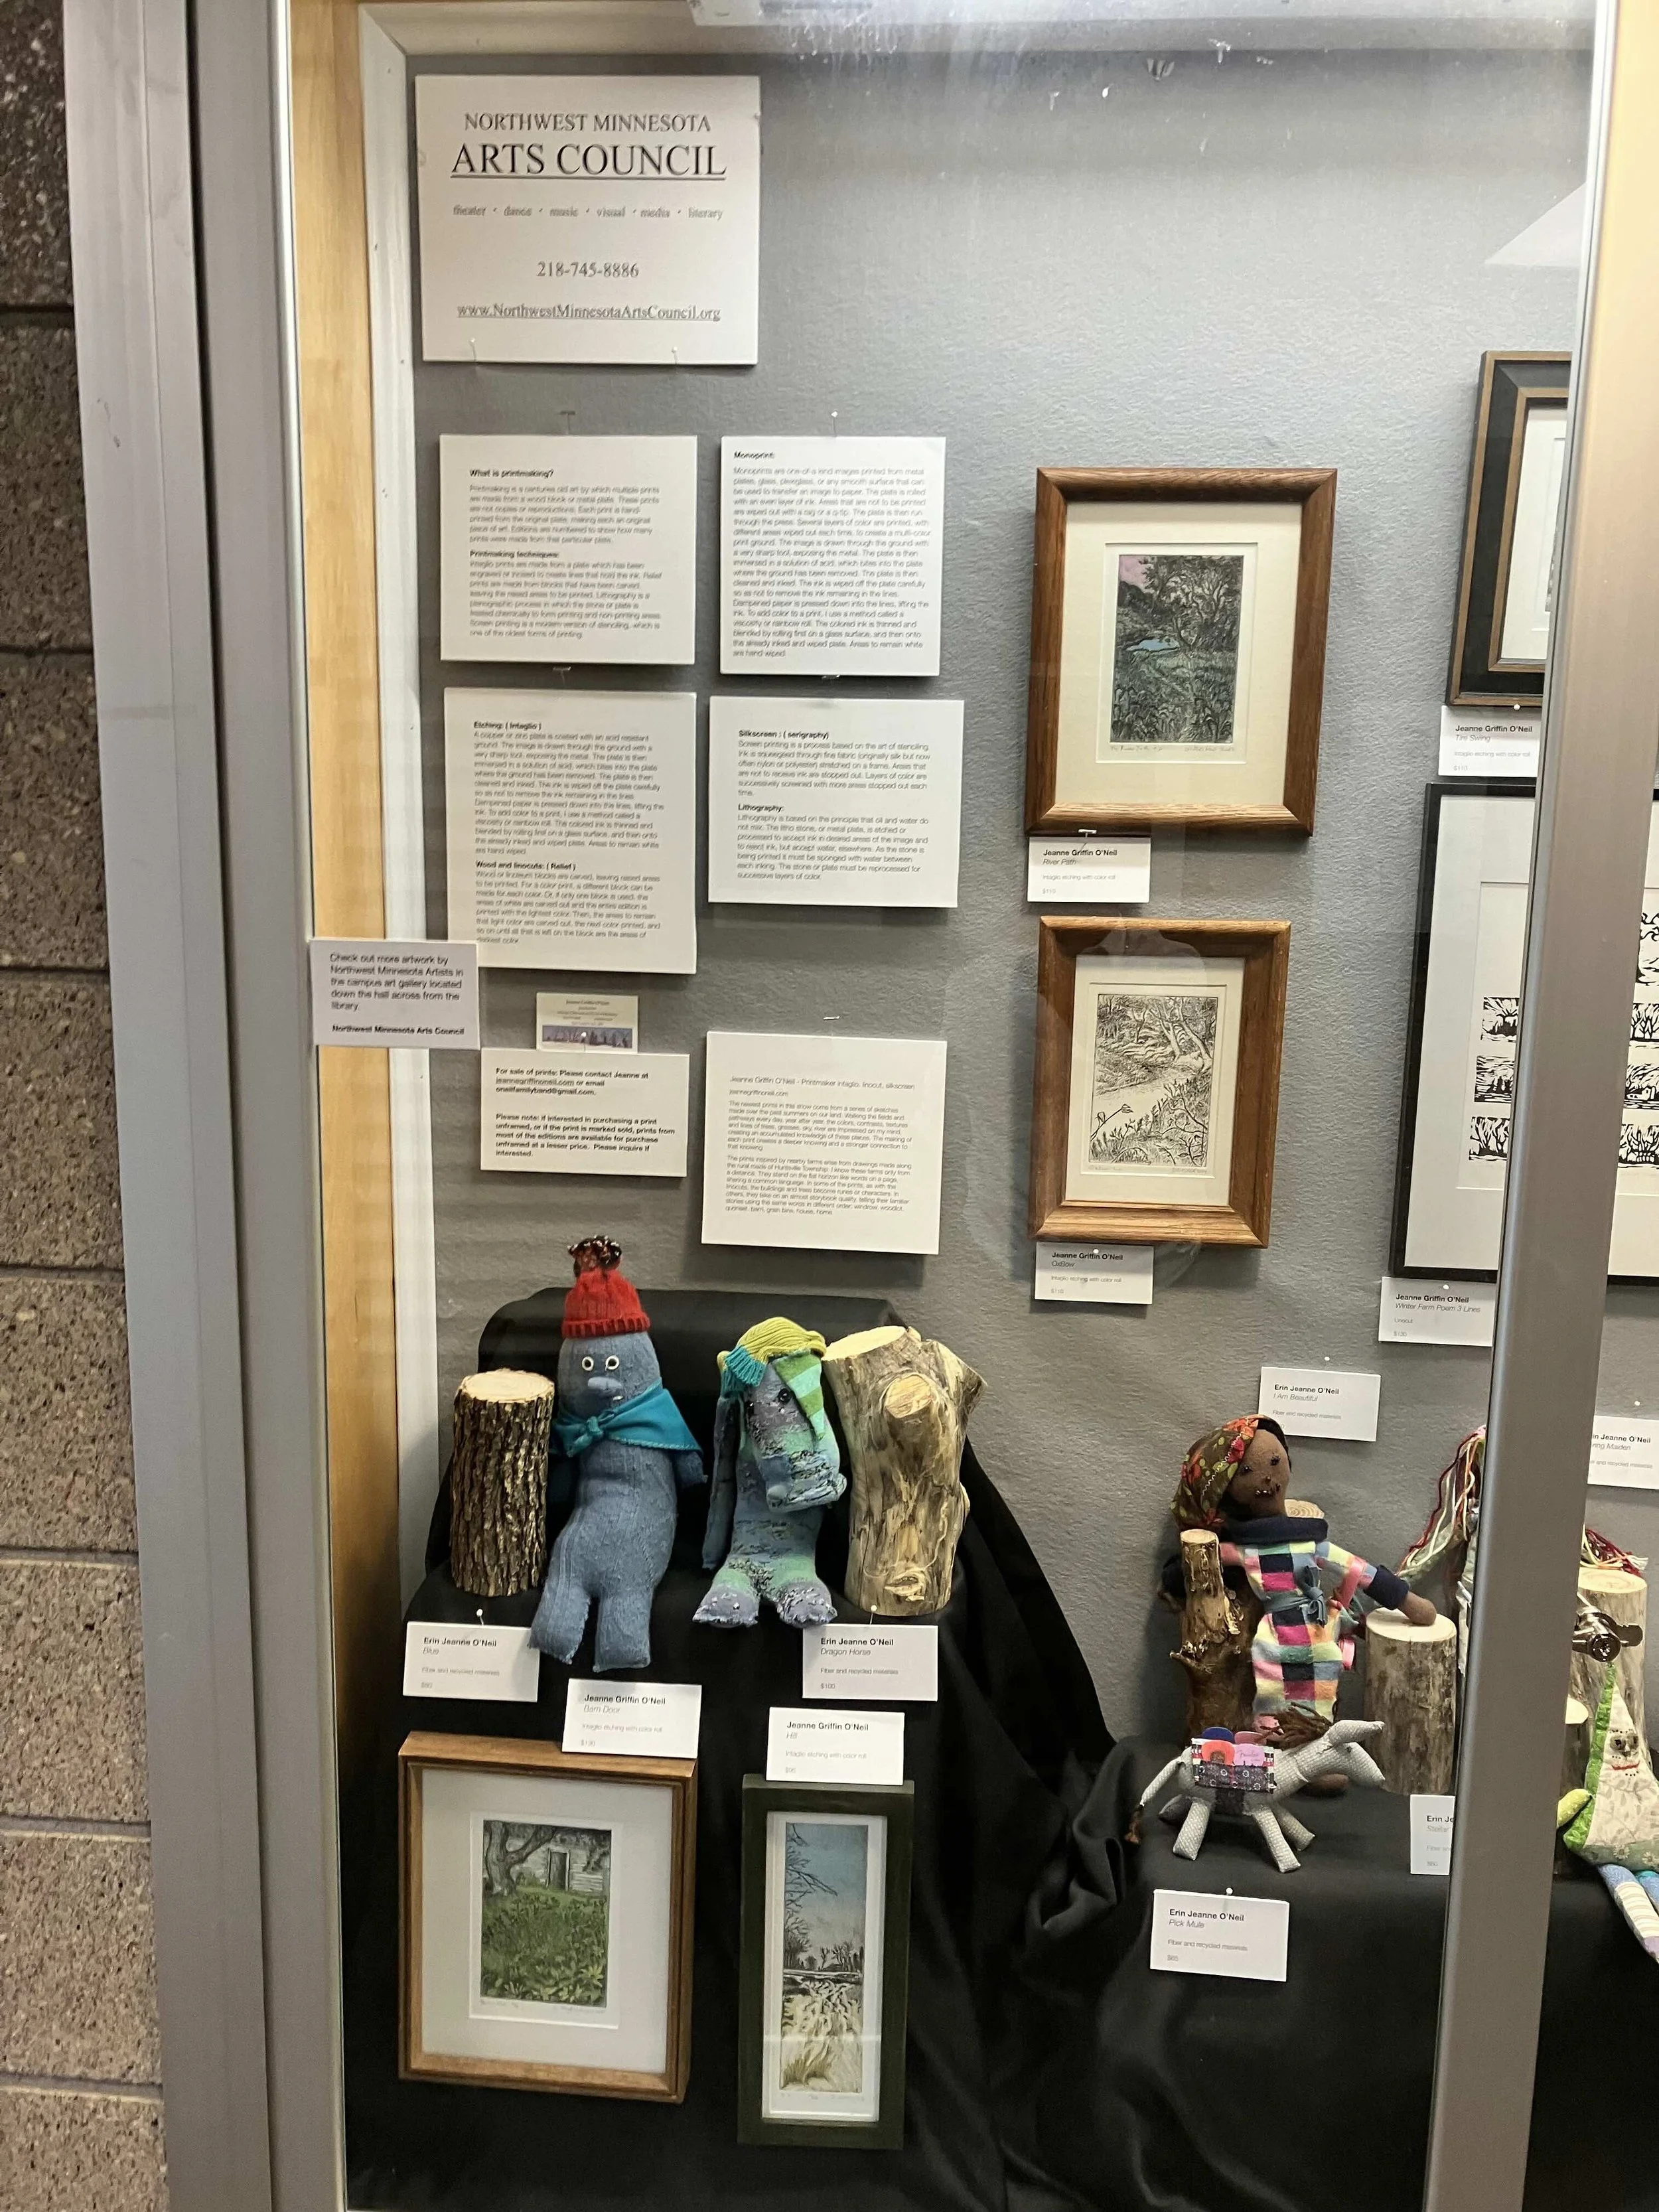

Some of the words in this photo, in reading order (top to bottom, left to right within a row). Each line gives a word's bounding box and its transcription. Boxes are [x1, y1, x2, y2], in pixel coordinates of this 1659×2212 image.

[465, 113, 588, 131] NORTHWEST
[594, 114, 711, 131] MINNESOTA
[453, 144, 544, 177] ARTS
[557, 145, 726, 175] COUNCIL
[504, 206, 532, 216] dance
[550, 206, 579, 217] music
[597, 206, 626, 218] visual
[640, 207, 670, 218] media
[689, 208, 723, 220] literary
[538, 262, 639, 277] 218-745-8886
[457, 305, 721, 321] www.NorthwestMinnesotaArtsCouncil.org
[502, 470, 554, 479] printmaking?
[1469, 734, 1492, 743] Swing
[330, 952, 358, 962] Check
[437, 956, 449, 966] by
[330, 966, 375, 975] Northwest
[378, 966, 423, 976] Minnesota
[425, 968, 454, 976] Artists
[347, 979, 382, 988] campus
[398, 980, 427, 990] gallery
[429, 980, 462, 989] located
[423, 992, 443, 1000] from
[543, 1124, 548, 1133] if
[820, 1647, 847, 1657] Dragon
[1188, 1911, 1217, 1919] Jeanne
